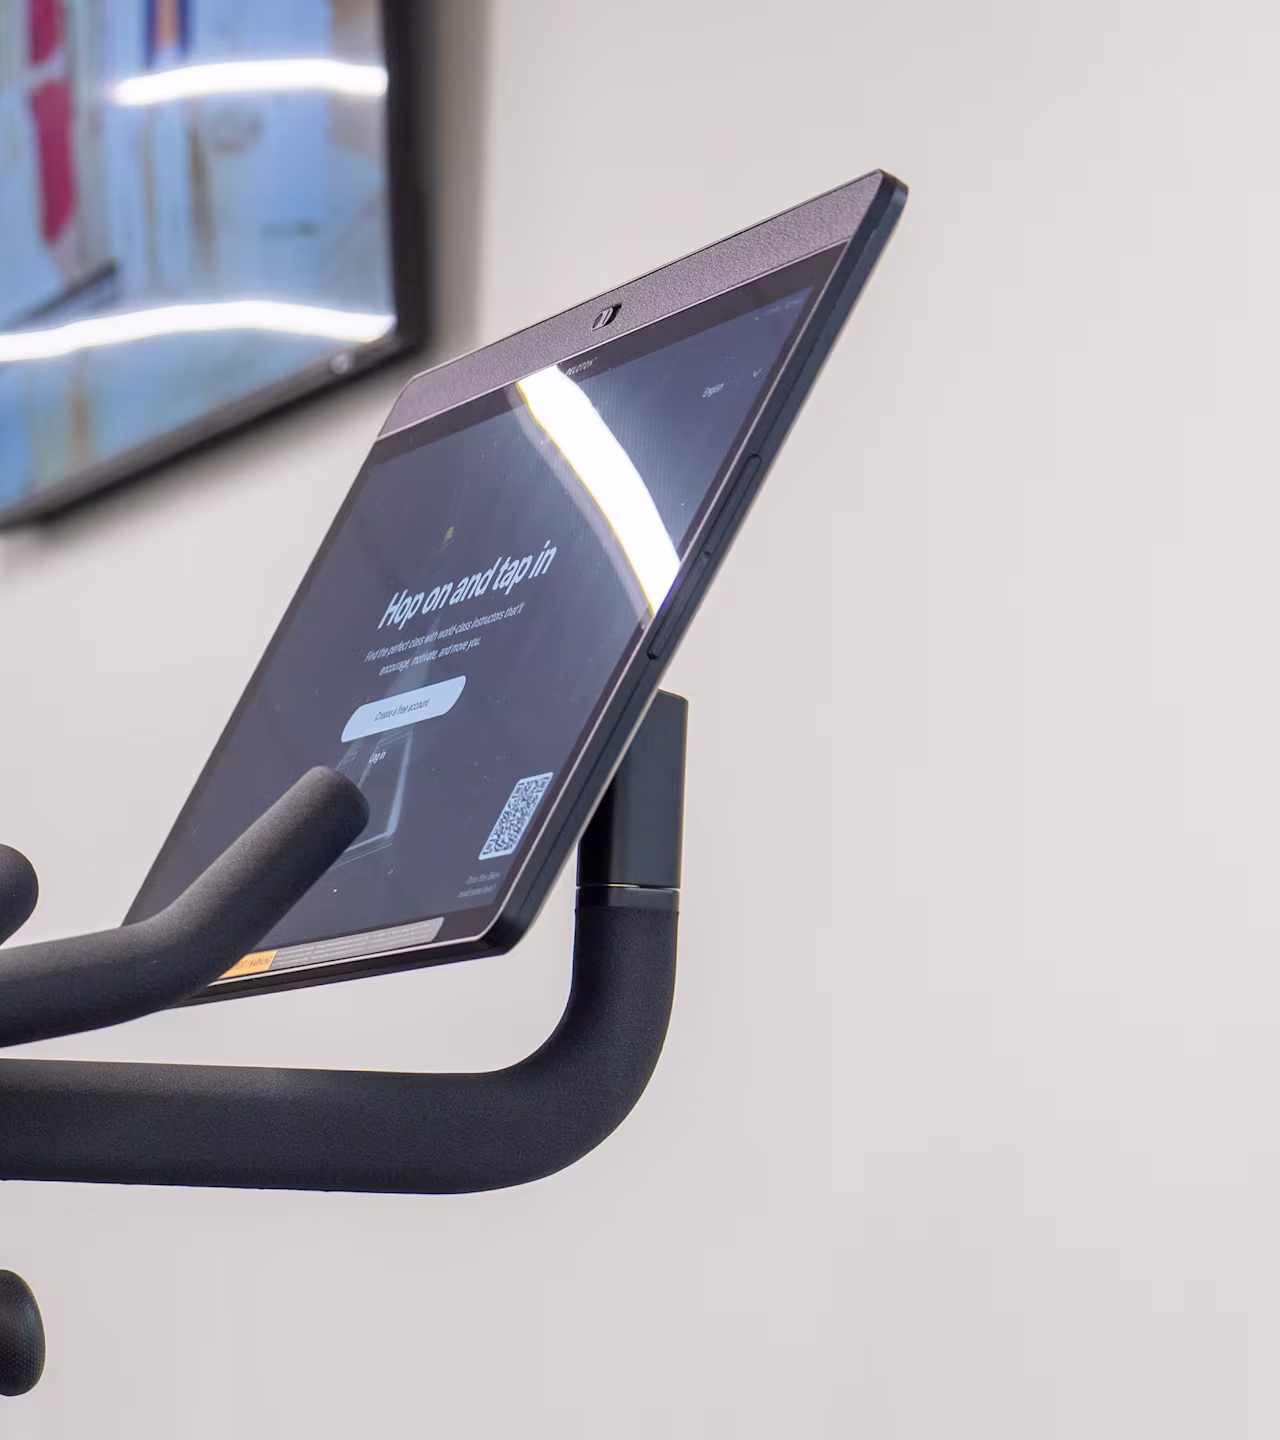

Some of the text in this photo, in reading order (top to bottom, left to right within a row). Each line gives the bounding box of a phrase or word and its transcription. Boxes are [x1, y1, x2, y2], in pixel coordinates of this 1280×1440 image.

[377, 539, 557, 630] Hop on and tap in
[368, 751, 382, 765] Log
